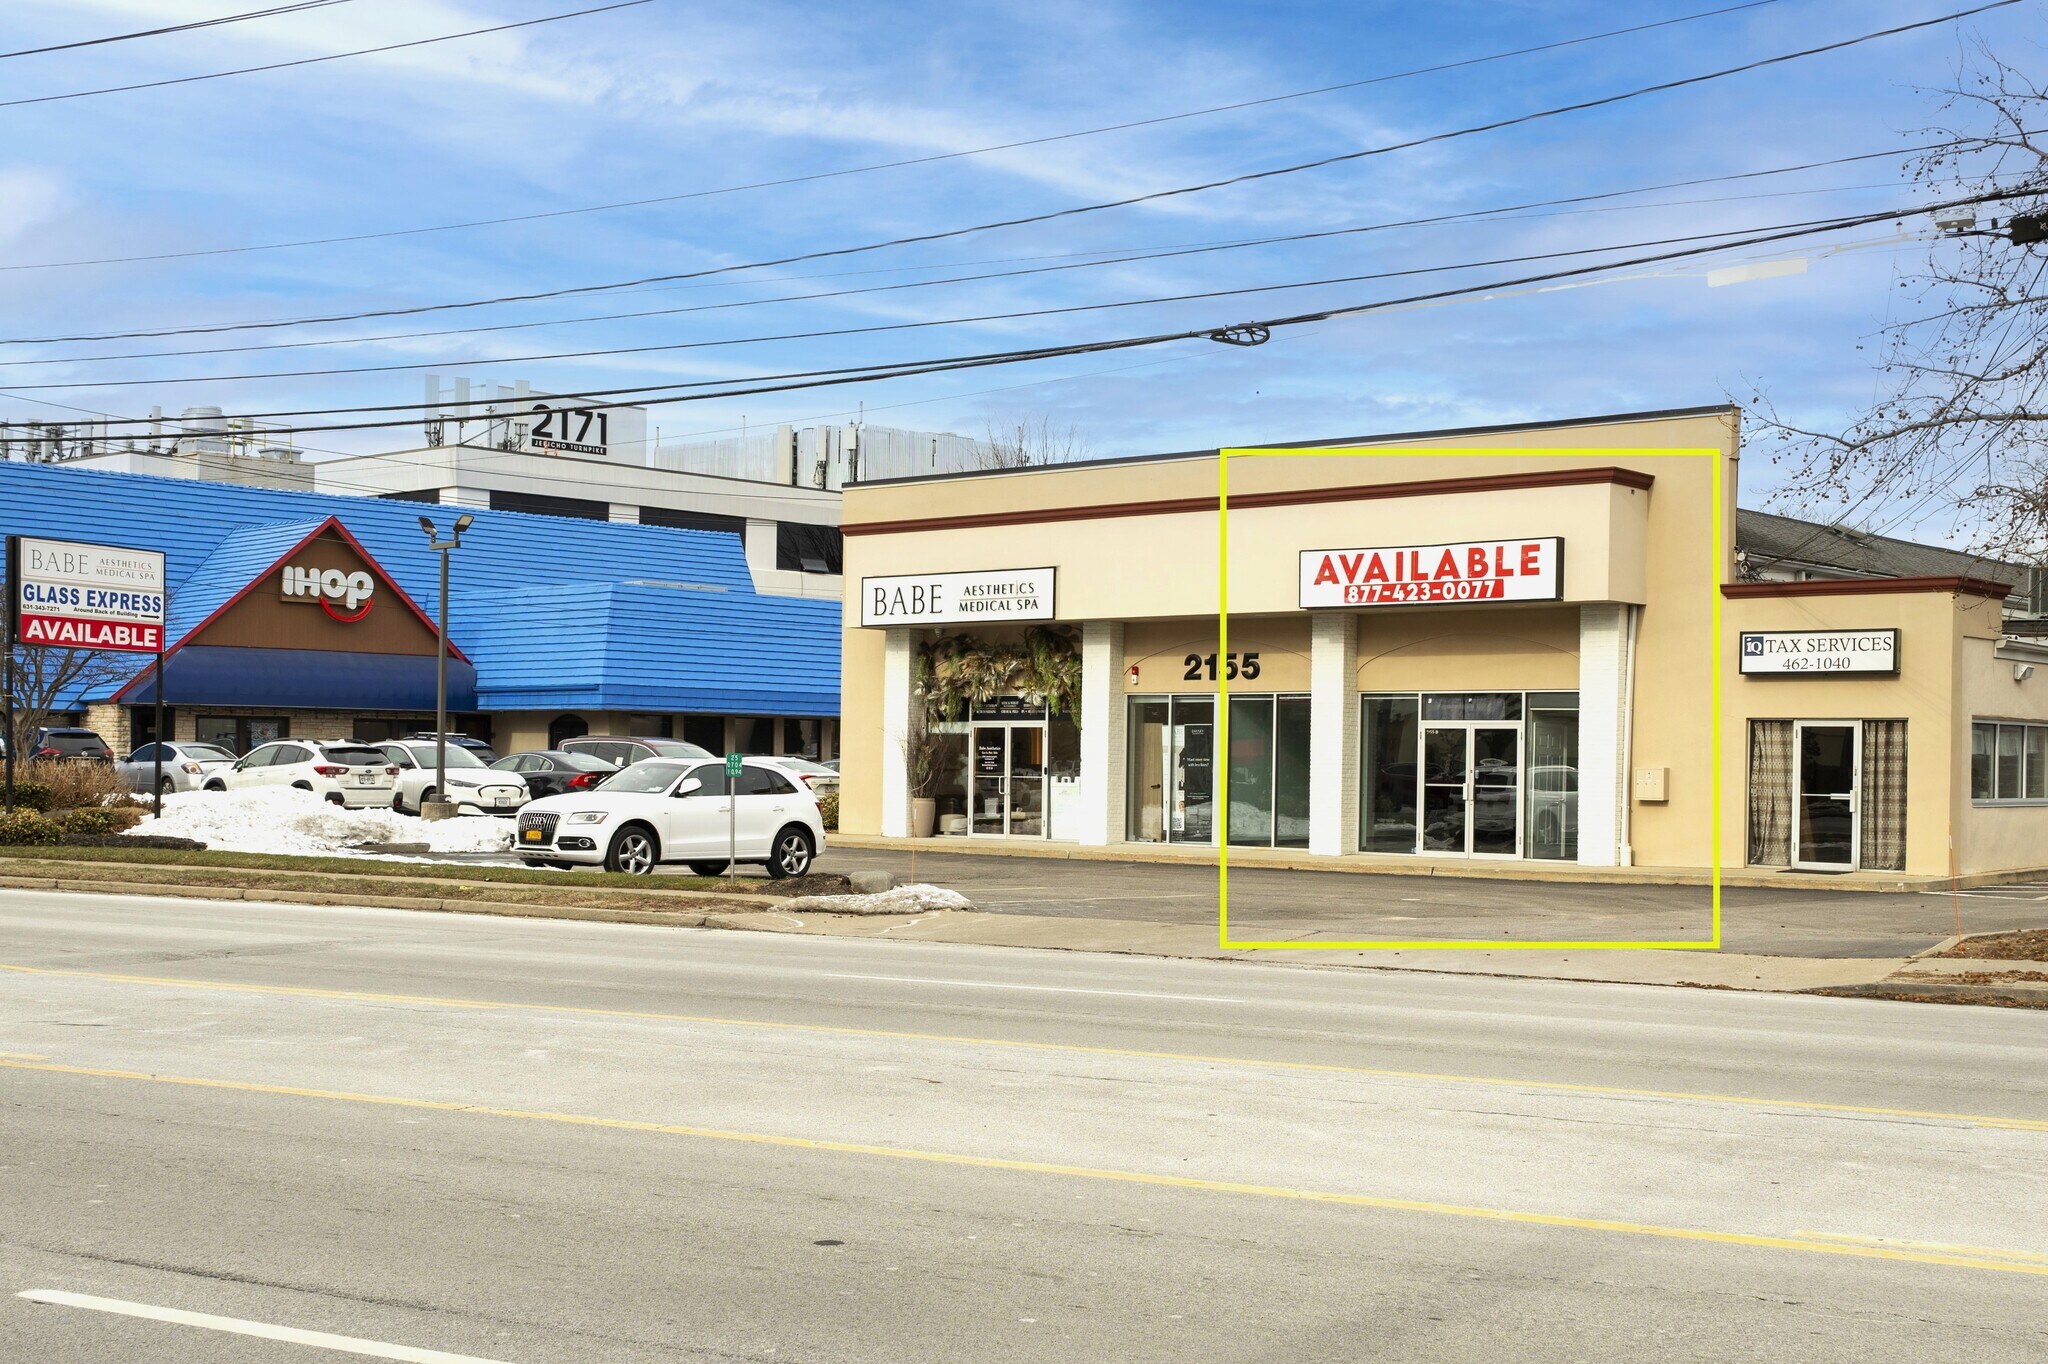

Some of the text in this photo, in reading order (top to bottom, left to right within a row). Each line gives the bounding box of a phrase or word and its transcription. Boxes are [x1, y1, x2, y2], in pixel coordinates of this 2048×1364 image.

[532, 404, 608, 446] 2171
[570, 444, 604, 454] TURNPIKE
[32, 549, 153, 575] BABE AESTHETICS
[1313, 543, 1541, 586] AVAILABLE
[95, 568, 155, 581] MEDICAL SPA
[23, 583, 162, 613] GLASS EXPRESS
[282, 565, 374, 610] IHOP
[873, 582, 1035, 616] BABE AESTHETICS
[1347, 580, 1496, 603] 877-423-0077
[22, 604, 60, 612] 631-343-7271
[73, 606, 94, 614] Around
[117, 610, 138, 619] Building
[959, 598, 1039, 612] MEDICAL SPA
[26, 619, 158, 648] AVAILABLE
[1765, 638, 1802, 654] TAX
[1806, 636, 1892, 653] SERVICES
[1183, 652, 1261, 681] 2155
[1782, 656, 1851, 671] 462-1040
